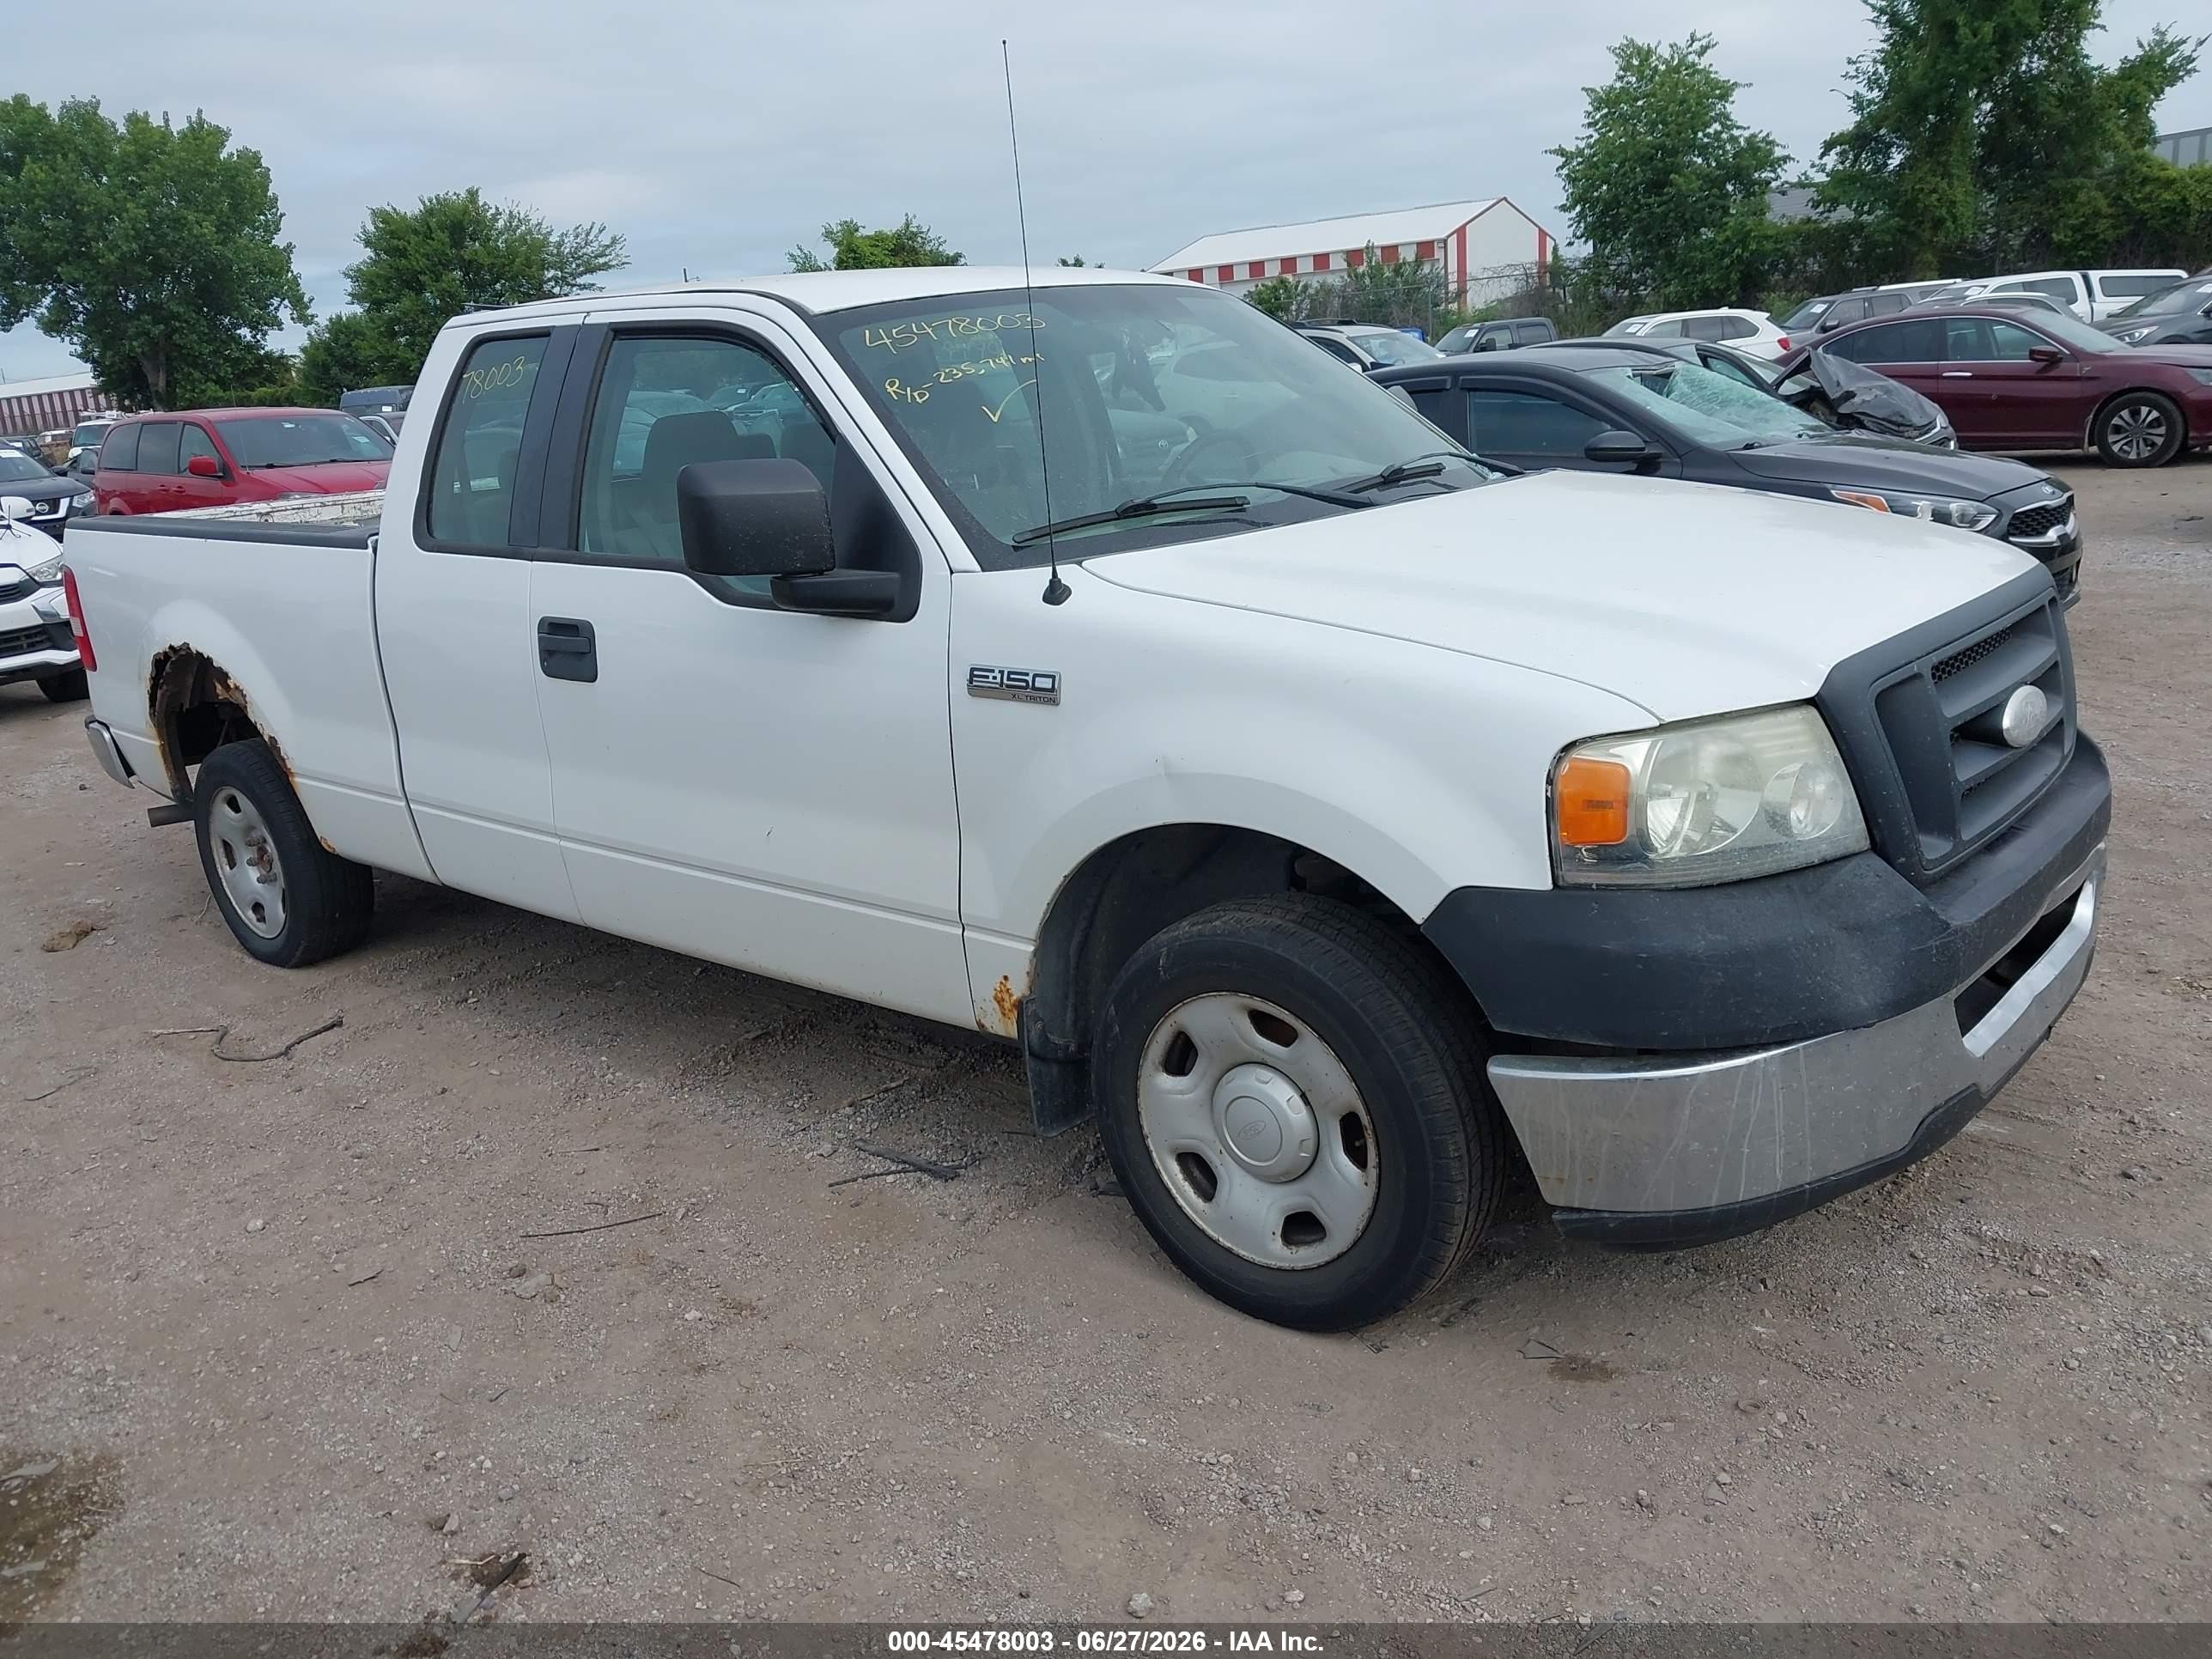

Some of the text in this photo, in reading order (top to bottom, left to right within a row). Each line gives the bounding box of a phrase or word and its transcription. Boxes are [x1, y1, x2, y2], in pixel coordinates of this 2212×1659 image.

[865, 313, 1046, 355] 45478003
[462, 356, 525, 404] 78003
[969, 667, 1056, 693] F-150
[1024, 695, 1055, 703] TRITON
